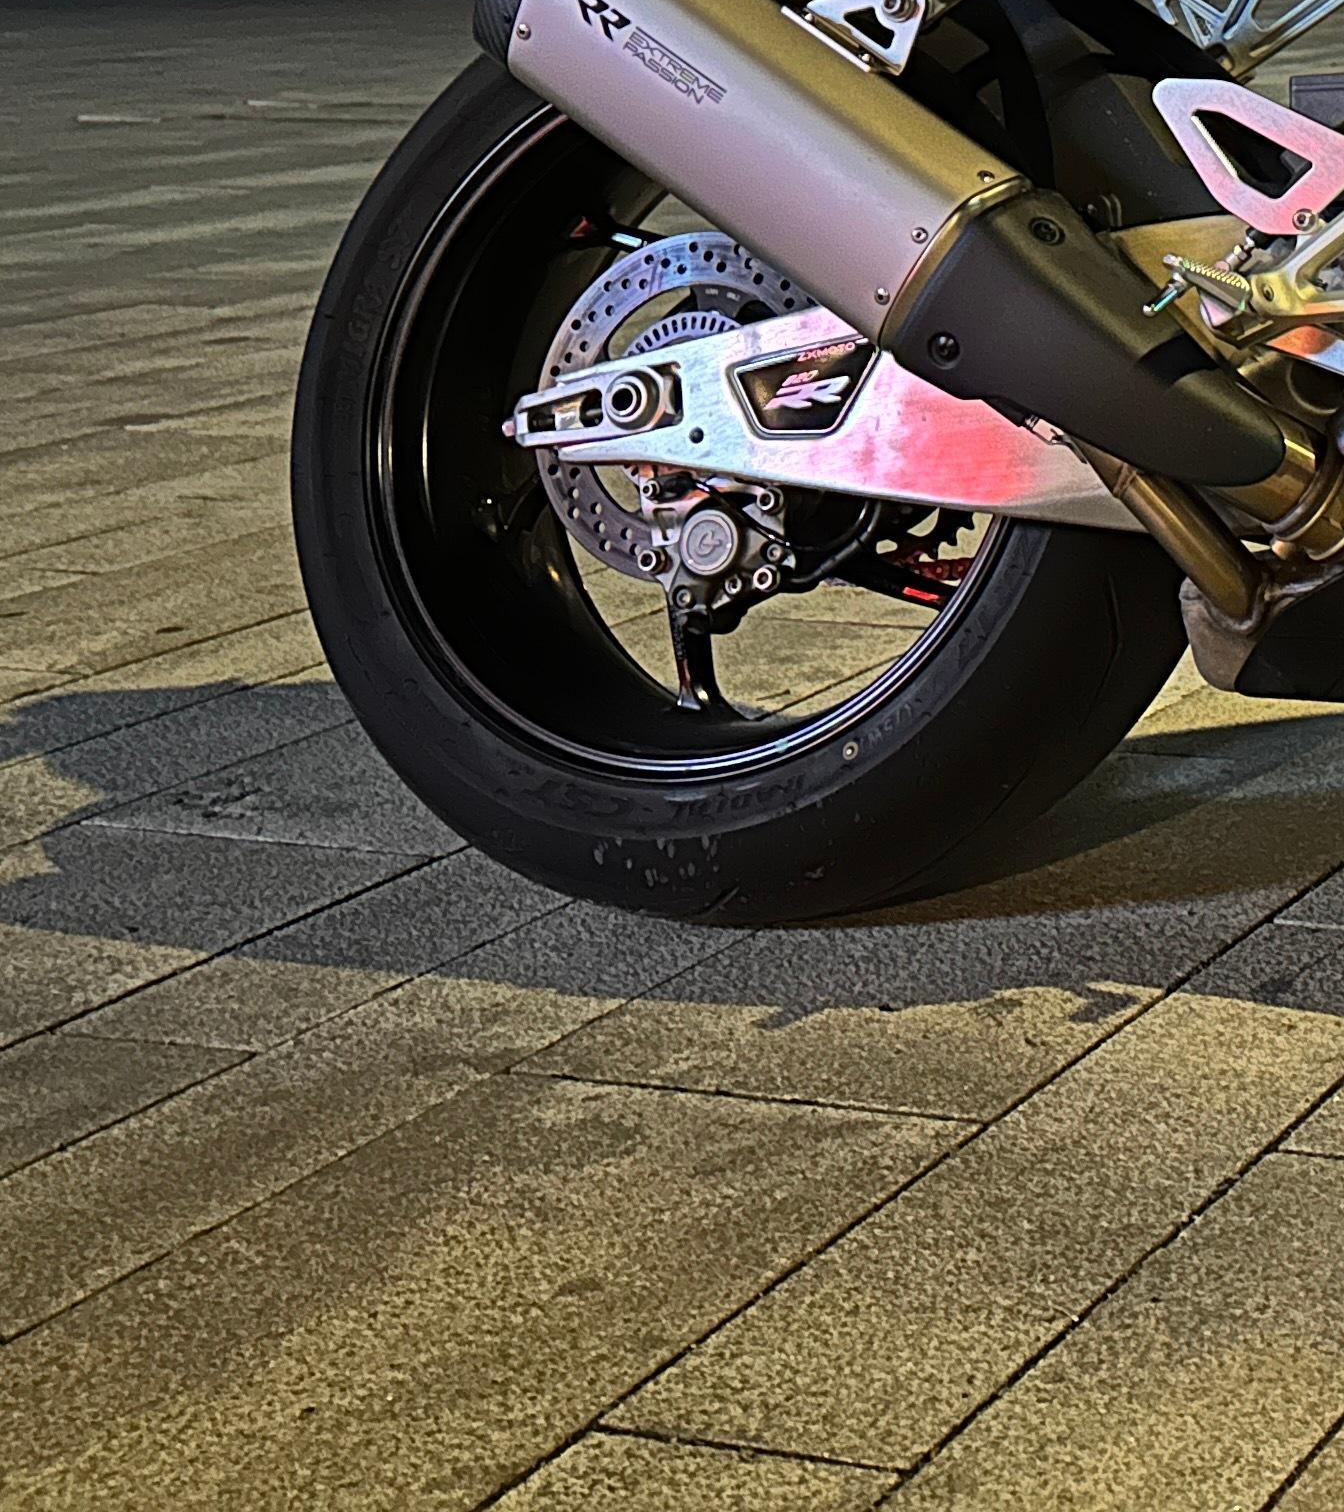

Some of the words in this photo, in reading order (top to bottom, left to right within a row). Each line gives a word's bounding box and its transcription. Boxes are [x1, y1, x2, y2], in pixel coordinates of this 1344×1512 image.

[622, 41, 704, 105] PASSION
[628, 31, 725, 104] EXTREME
[797, 341, 856, 362] ZXMOTO
